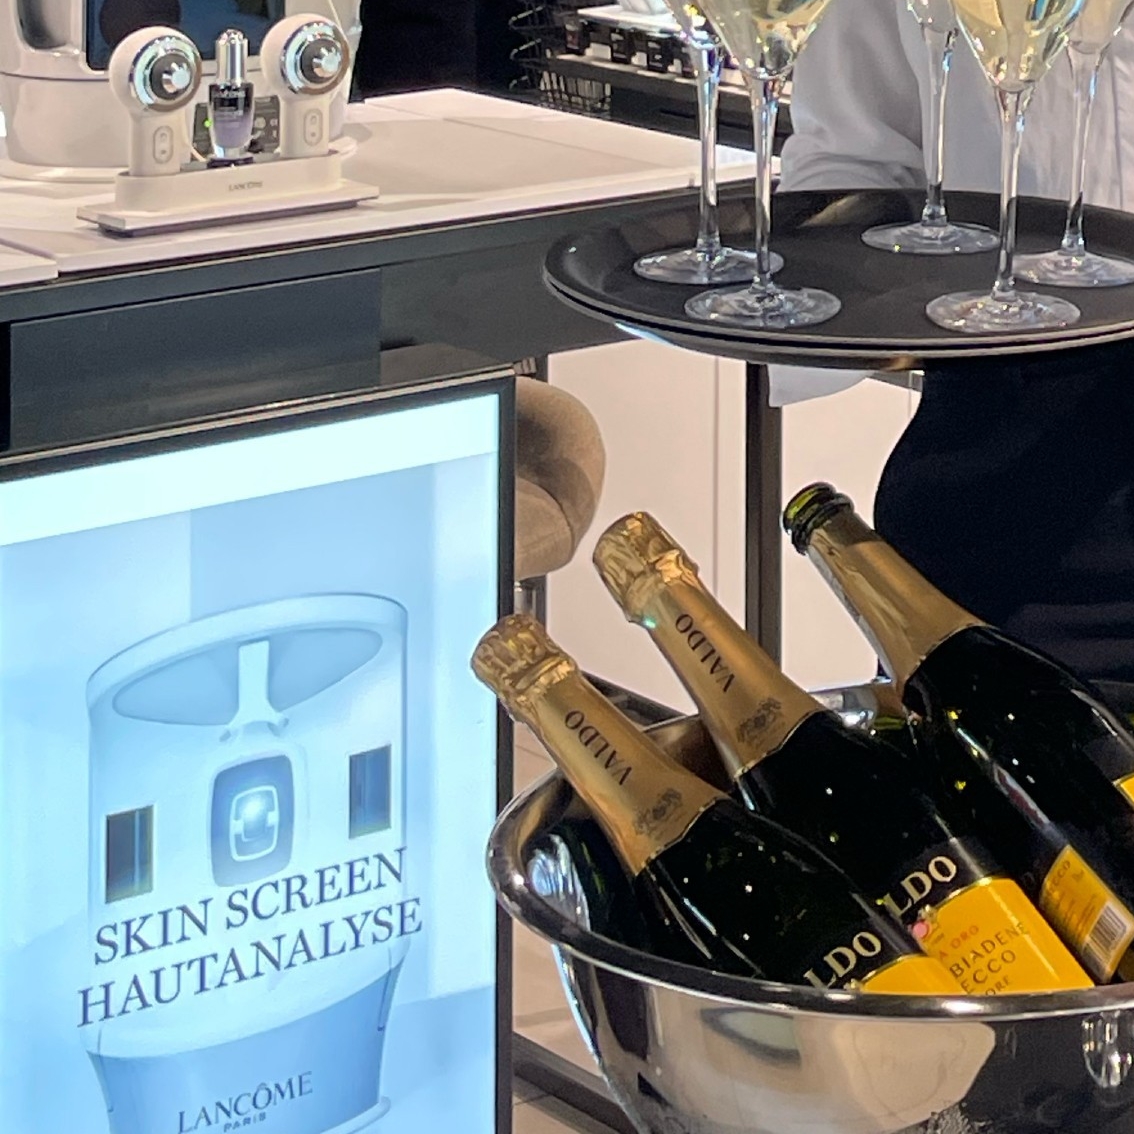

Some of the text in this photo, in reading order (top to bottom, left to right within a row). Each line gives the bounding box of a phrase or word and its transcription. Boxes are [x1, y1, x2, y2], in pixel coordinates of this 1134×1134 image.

[674, 613, 736, 693] VALDO
[564, 709, 632, 786] VALDO
[94, 846, 408, 966] SKIN SCREEN
[77, 897, 423, 1028] HAUTANALYSE
[178, 1070, 313, 1134] LANCÔME
[223, 1111, 267, 1133] PARIS
